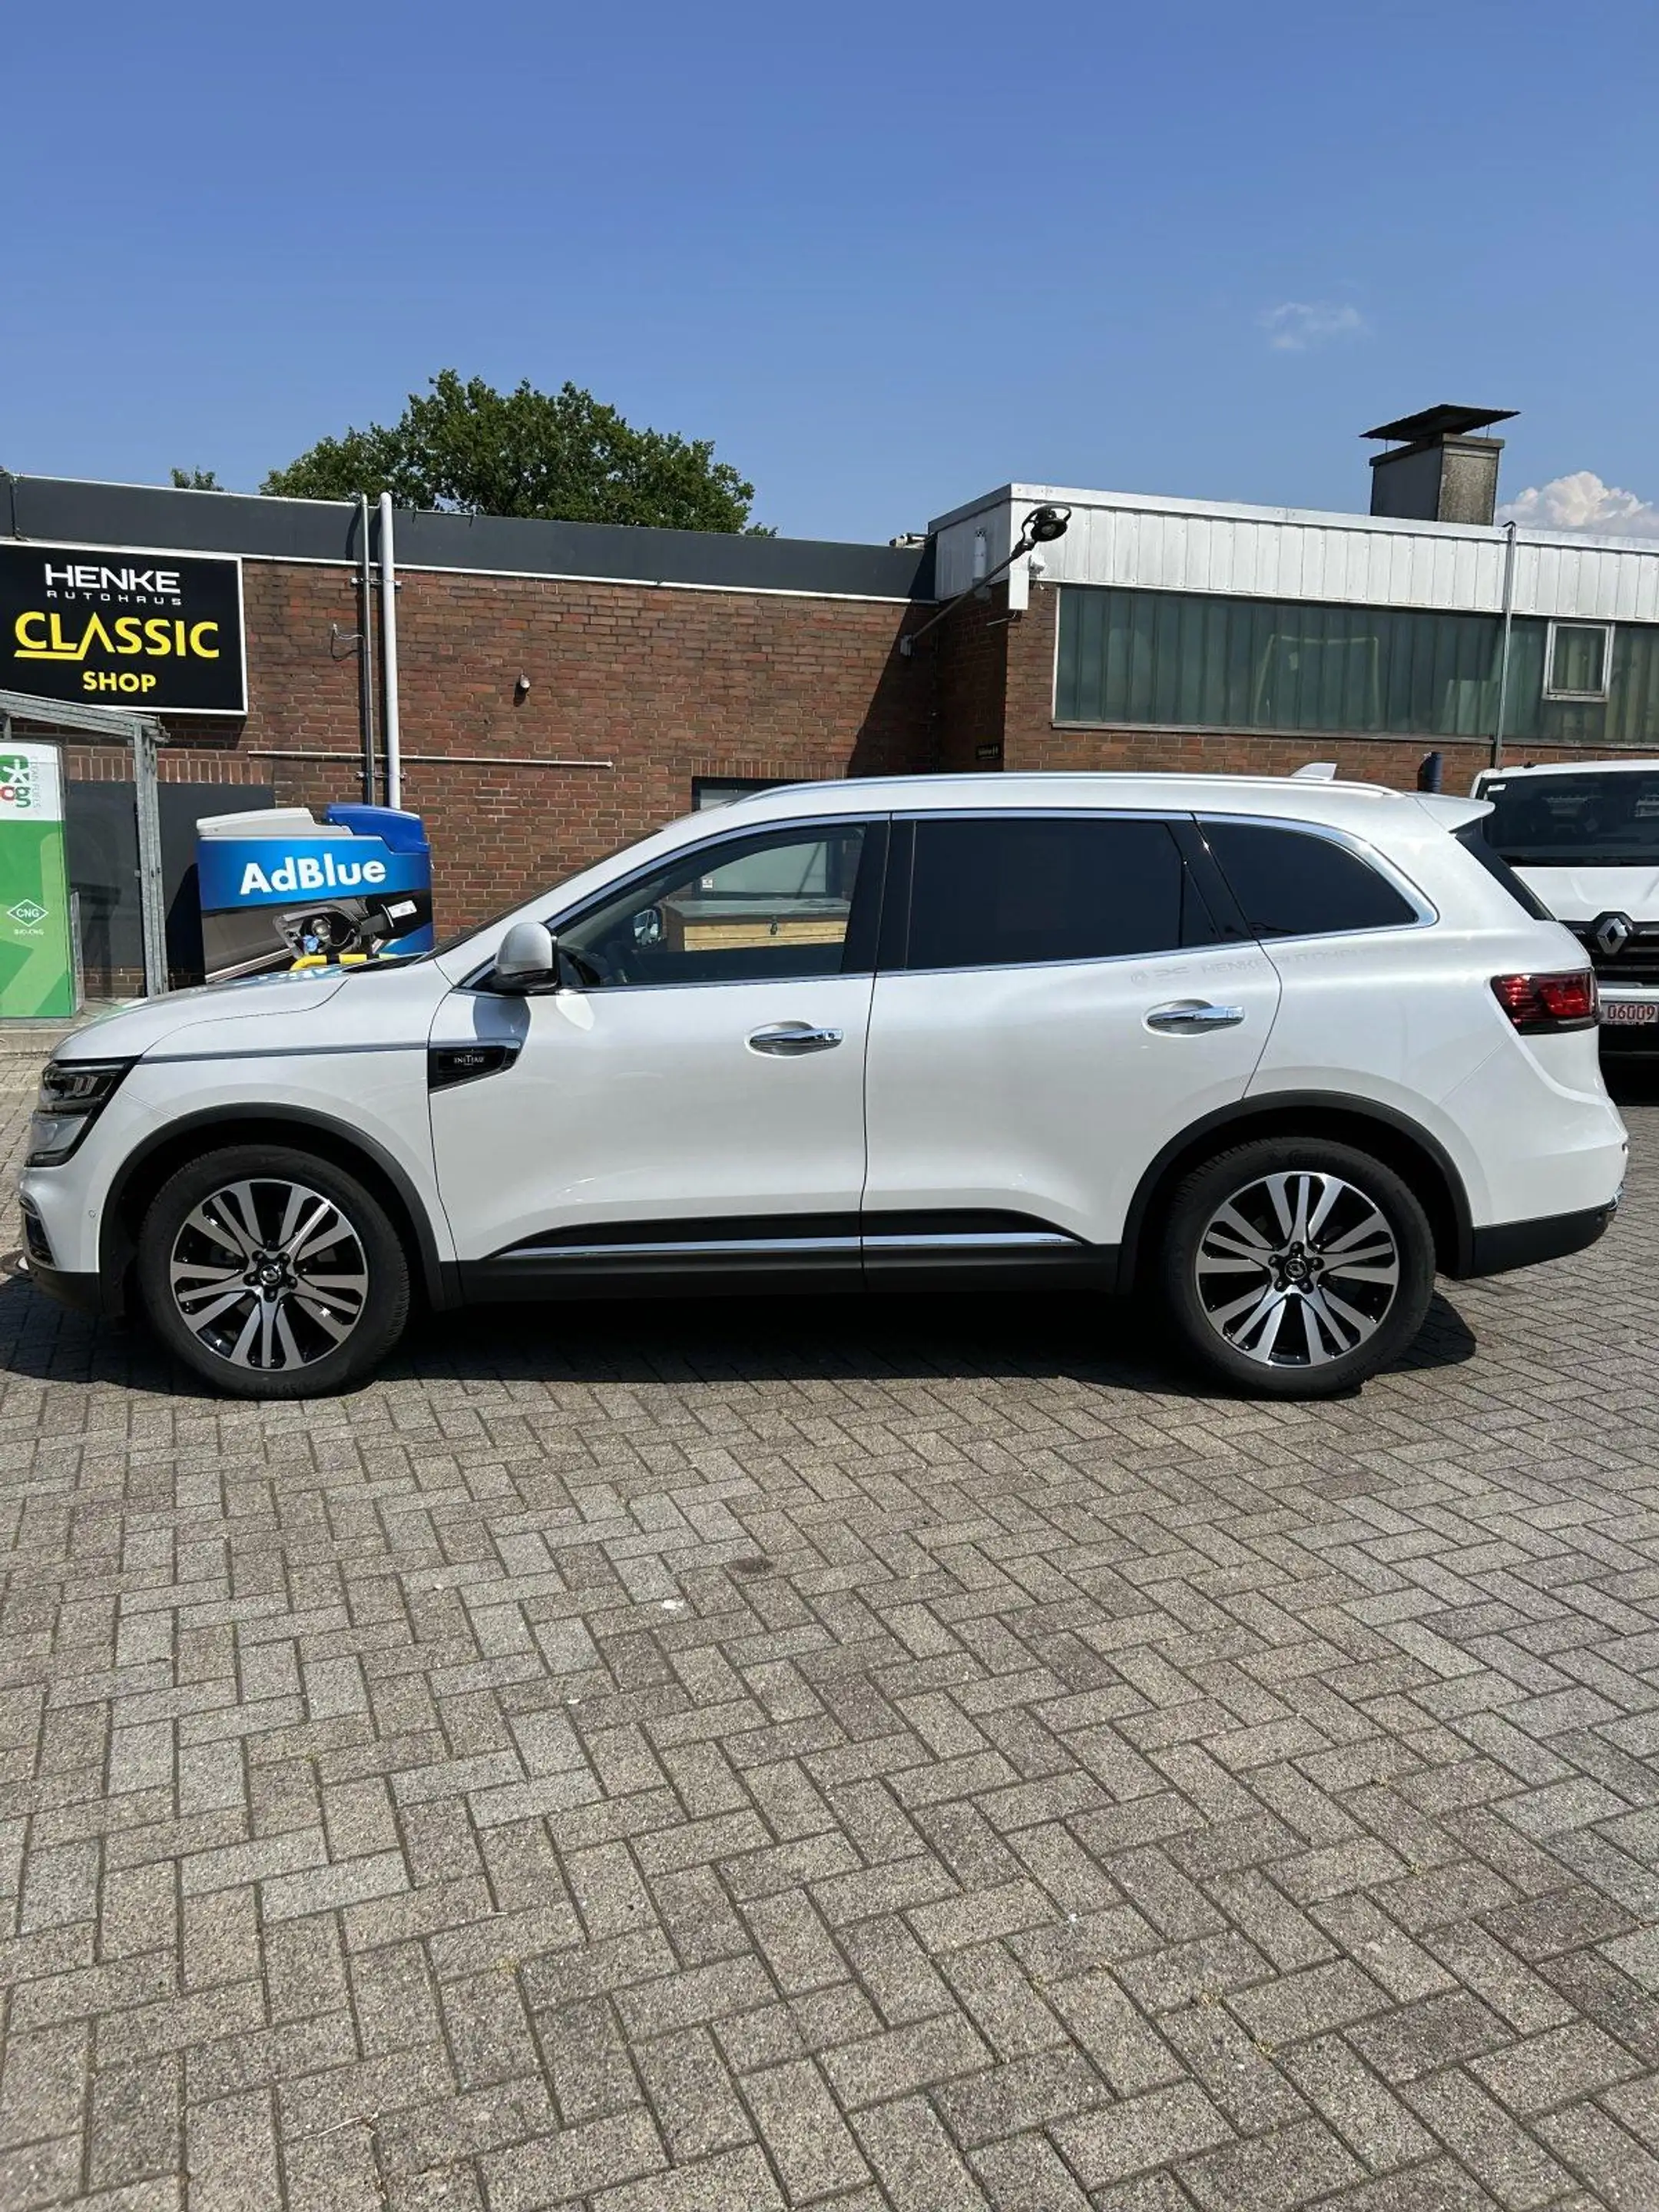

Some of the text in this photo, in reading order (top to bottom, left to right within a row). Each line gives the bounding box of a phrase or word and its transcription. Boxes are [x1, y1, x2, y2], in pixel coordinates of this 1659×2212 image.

[45, 564, 181, 594] HENKE
[46, 590, 182, 606] AUTOHAUS
[14, 611, 220, 661] CLASSIC
[82, 671, 157, 692] SHOP
[240, 852, 387, 896] AdBlue
[16, 908, 40, 918] CNG
[1608, 1005, 1656, 1020] 06009
